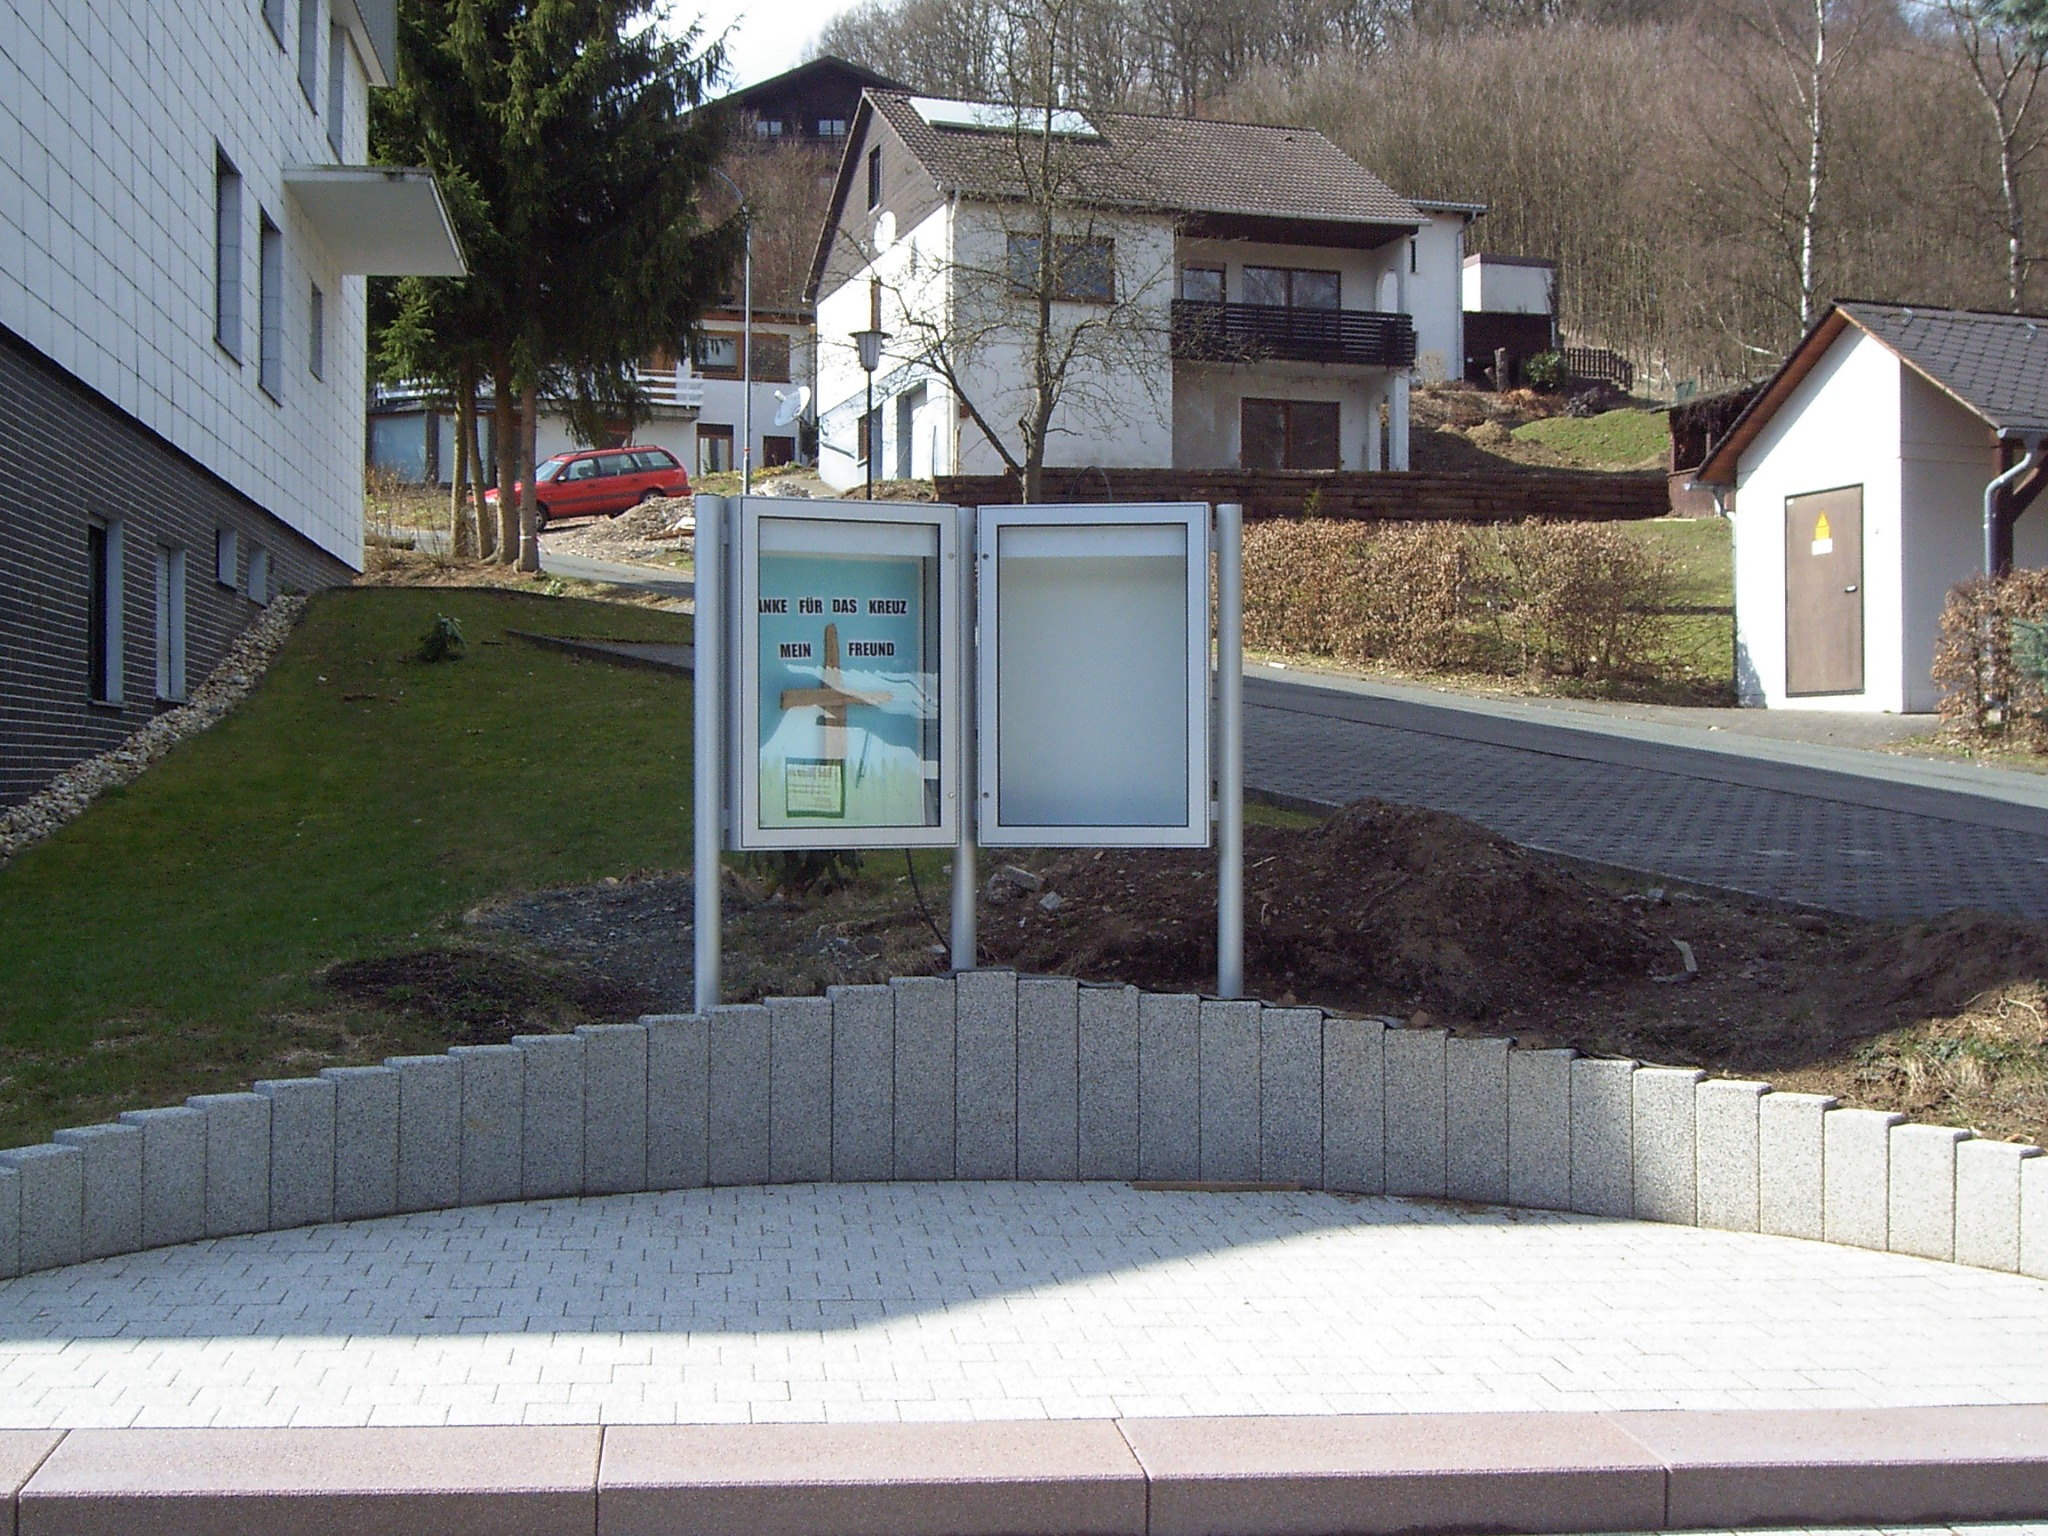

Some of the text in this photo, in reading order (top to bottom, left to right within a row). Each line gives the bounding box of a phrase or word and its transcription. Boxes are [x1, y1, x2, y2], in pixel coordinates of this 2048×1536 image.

[799, 597, 823, 614] FÜR
[832, 599, 857, 613] DAS
[868, 600, 907, 614] KREUZ
[779, 642, 895, 658] MEIN FREUND
